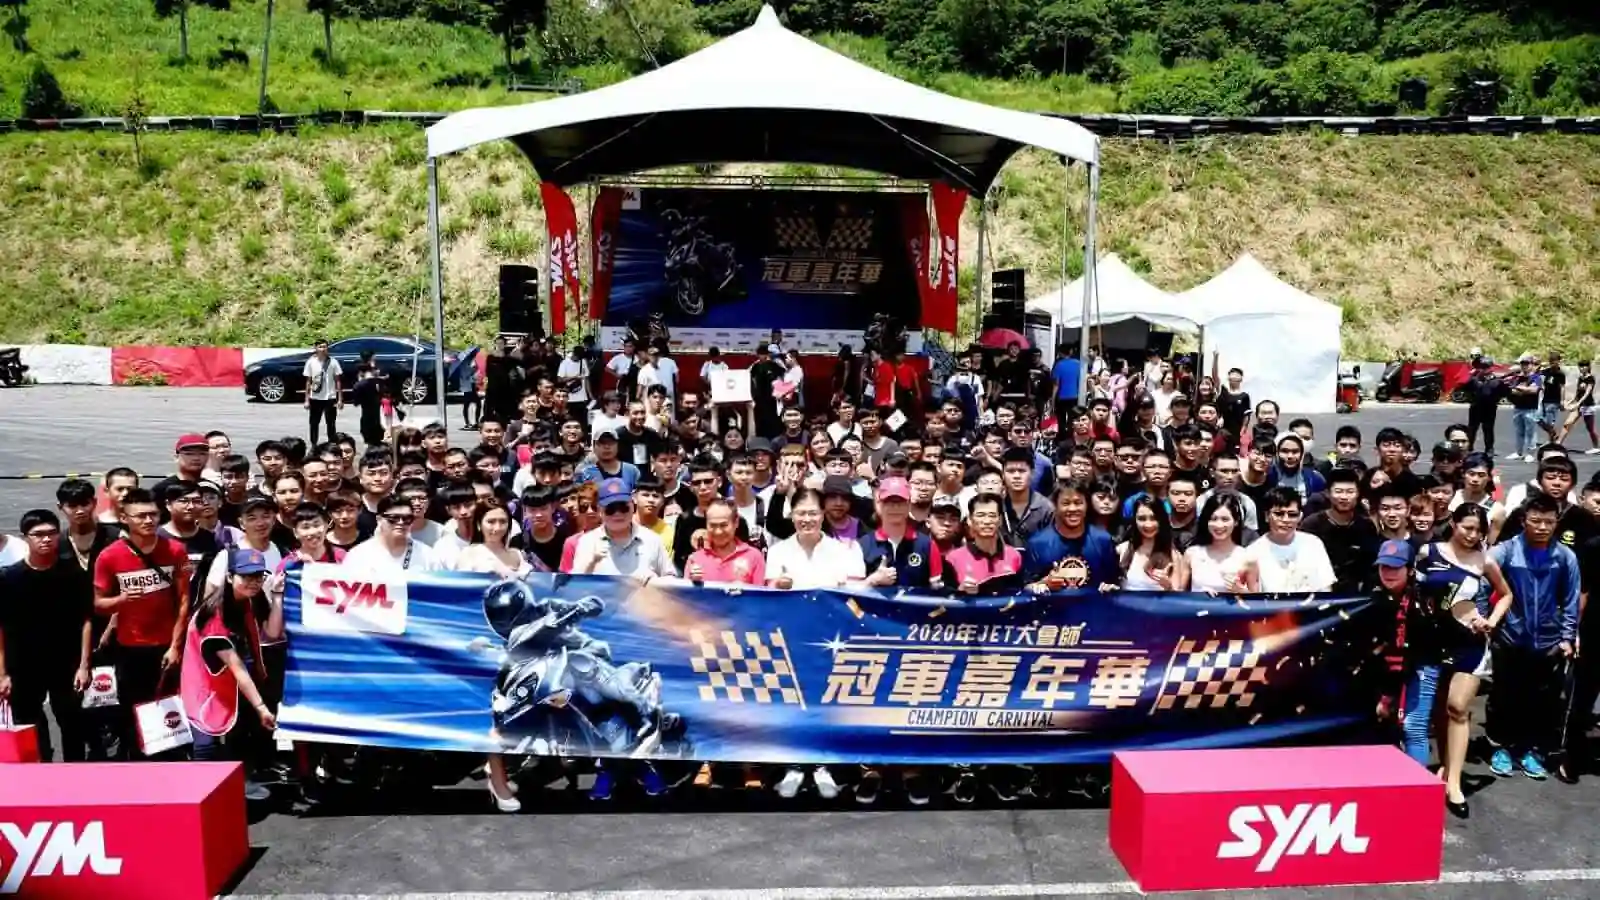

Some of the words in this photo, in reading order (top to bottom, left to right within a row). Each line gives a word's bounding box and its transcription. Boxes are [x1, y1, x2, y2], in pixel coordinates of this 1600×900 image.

[315, 580, 395, 613] SYM
[821, 652, 1150, 709] 冠軍嘉年華
[907, 709, 978, 727] CHAMPION
[987, 711, 1055, 728] CARNIVAL
[0, 820, 123, 894] YM
[1216, 802, 1370, 872] SYM
